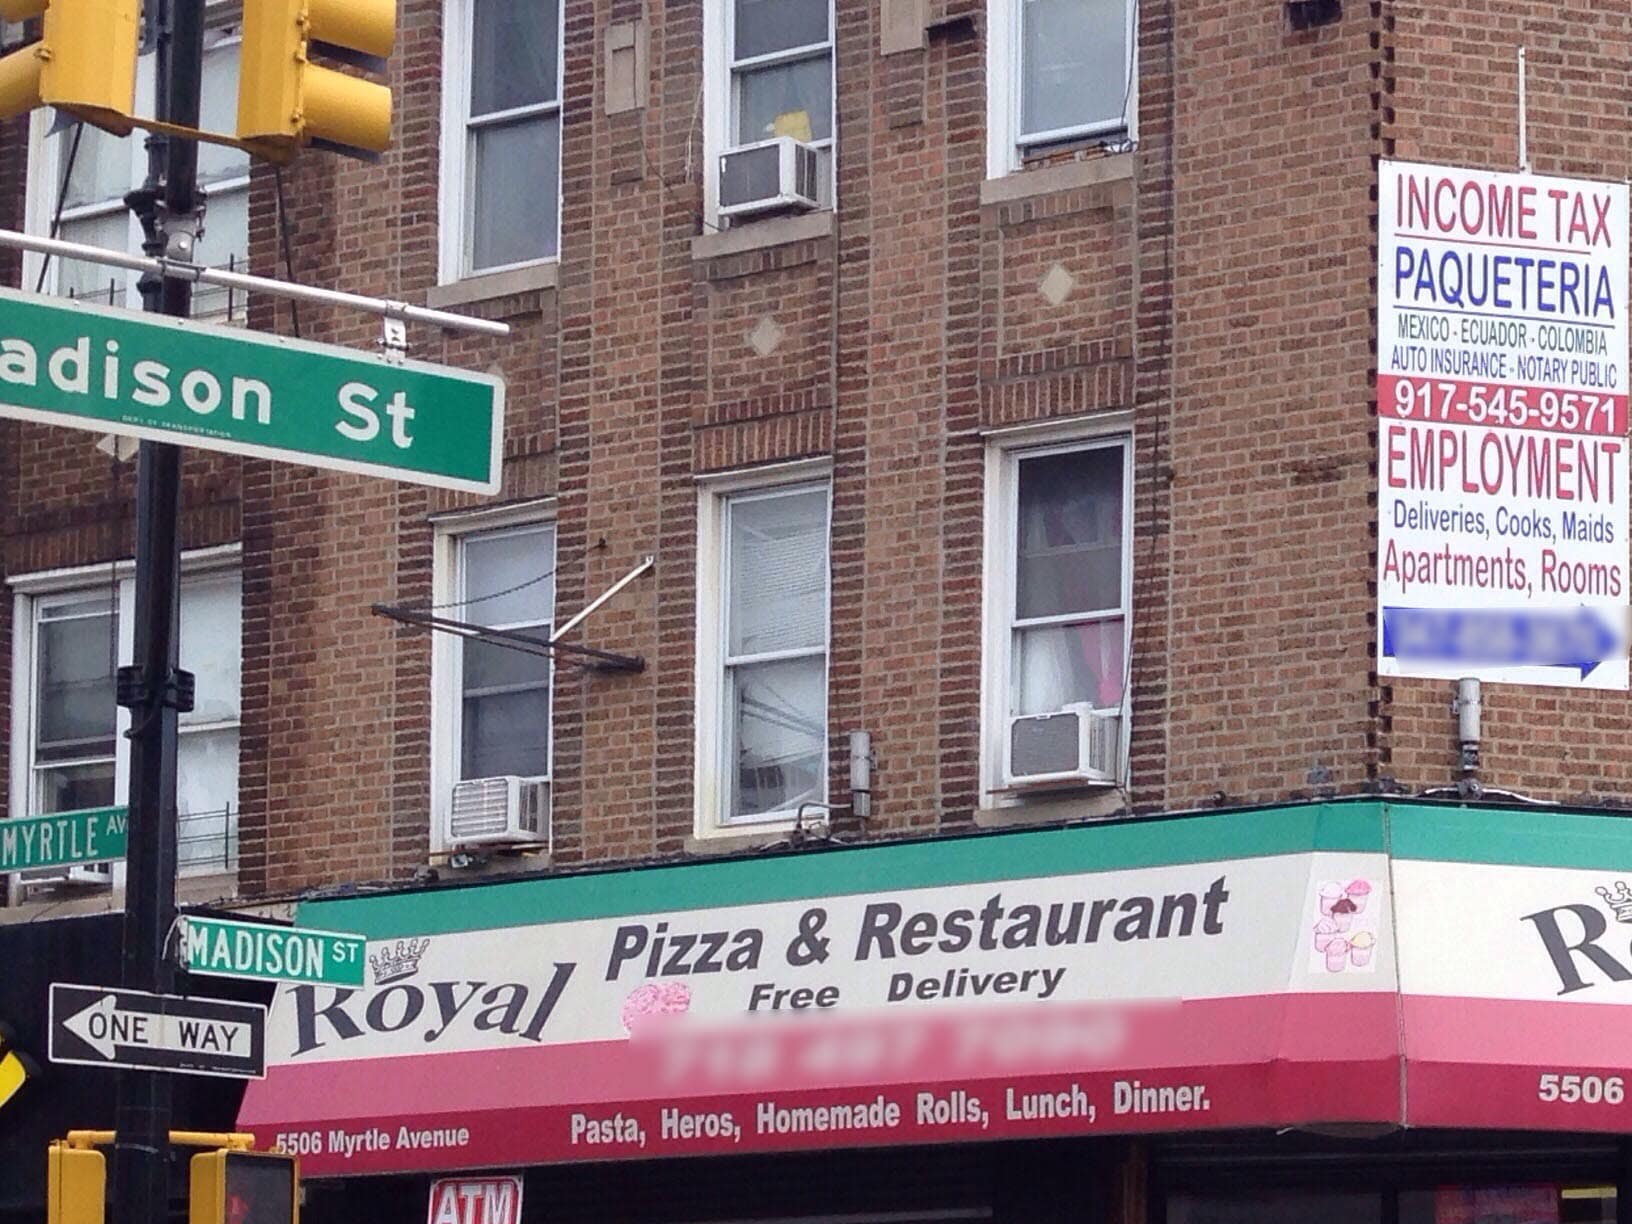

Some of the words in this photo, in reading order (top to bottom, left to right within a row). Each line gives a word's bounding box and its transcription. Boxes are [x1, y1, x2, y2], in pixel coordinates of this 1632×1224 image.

[1397, 173, 1537, 240] INCOME
[1548, 190, 1611, 248] TAX
[1395, 246, 1615, 319] PAQUETERIA
[1398, 314, 1450, 342] MEXICO
[1461, 318, 1527, 348] ECUADOR
[1538, 325, 1607, 355] COLOMBIA
[1391, 346, 1427, 372] AUTO
[1430, 349, 1507, 379] INSURANCE
[1517, 355, 1568, 383] NOTARY
[1571, 361, 1617, 389] PUBLIC
[335, 381, 415, 449] St
[1395, 381, 1615, 433] 917-545-9571
[1388, 425, 1621, 504] EMPLOYMENT
[1394, 499, 1490, 539] Deliveries,
[1496, 505, 1556, 544] Cooks,
[1562, 511, 1614, 544] Maids
[1383, 538, 1533, 599] Apartments,
[1541, 549, 1621, 597] Rooms
[2, 817, 99, 866] MYRTLE
[187, 924, 324, 978] MADISON
[332, 941, 358, 964] ST
[285, 962, 576, 1057] Royal
[605, 922, 764, 981] Pizza
[785, 907, 831, 967] &
[854, 875, 1230, 962] Restaurant
[748, 981, 840, 1011] Free
[887, 965, 1067, 1003] Delivery
[89, 1012, 148, 1044] ONE
[179, 1020, 238, 1051] WAY
[570, 1112, 647, 1147] Pasta,
[660, 1108, 741, 1143] Heros,
[756, 1097, 900, 1136] Homemade
[916, 1091, 990, 1130] Rolls,
[1006, 1084, 1096, 1124] Lunch,
[1113, 1080, 1211, 1116] Dinner.
[1538, 1074, 1624, 1105] 5506
[275, 1131, 322, 1156] 5506
[328, 1129, 391, 1155] Myrtle
[396, 1126, 470, 1151] Avenue
